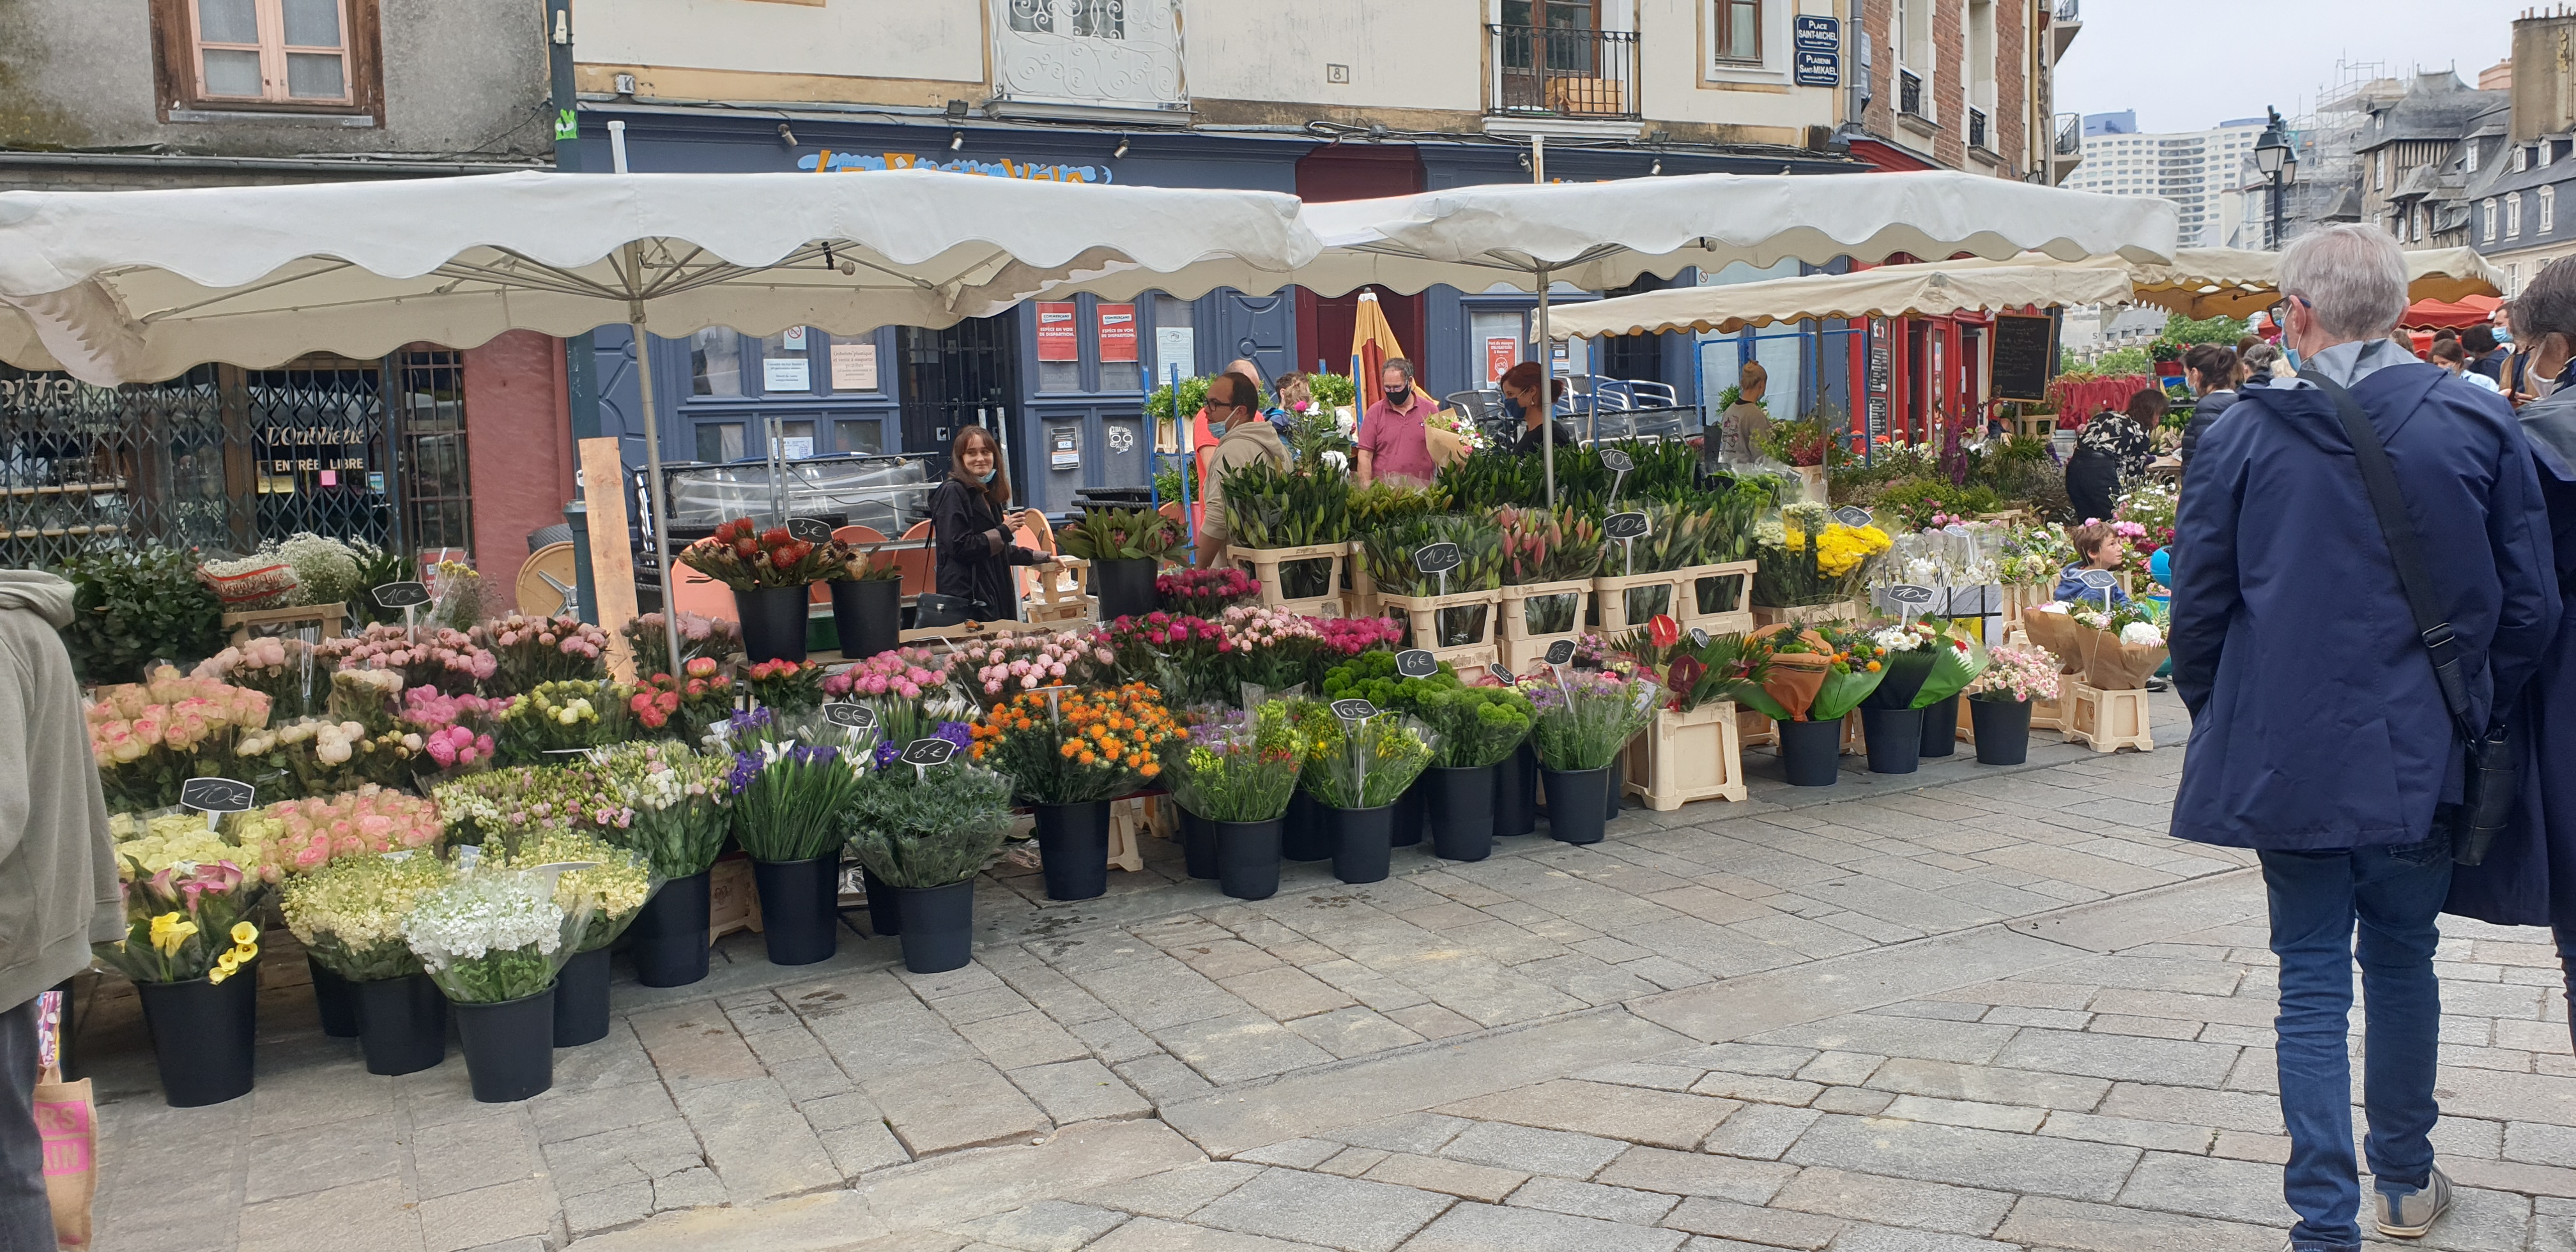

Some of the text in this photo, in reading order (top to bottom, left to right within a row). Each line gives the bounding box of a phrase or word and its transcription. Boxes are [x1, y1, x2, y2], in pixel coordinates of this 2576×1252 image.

[1809, 20, 1828, 30] PLACE
[1798, 29, 1837, 41] SAINT-MICHEL
[1806, 54, 1831, 65] PLASENN
[1333, 67, 1341, 80] 8
[1799, 64, 1837, 75] SANT-MIKAEL
[330, 457, 364, 470] LIBRE
[799, 520, 824, 537] 3€
[1609, 516, 1646, 532] 10€
[1423, 549, 1457, 566] 10€
[383, 588, 421, 604] 10€
[1894, 588, 1931, 600] 10€
[1407, 652, 1430, 669] 6€
[834, 706, 866, 724] 6€
[1340, 703, 1369, 716] 6€
[914, 741, 944, 759] 6€
[188, 784, 249, 805] 10€
